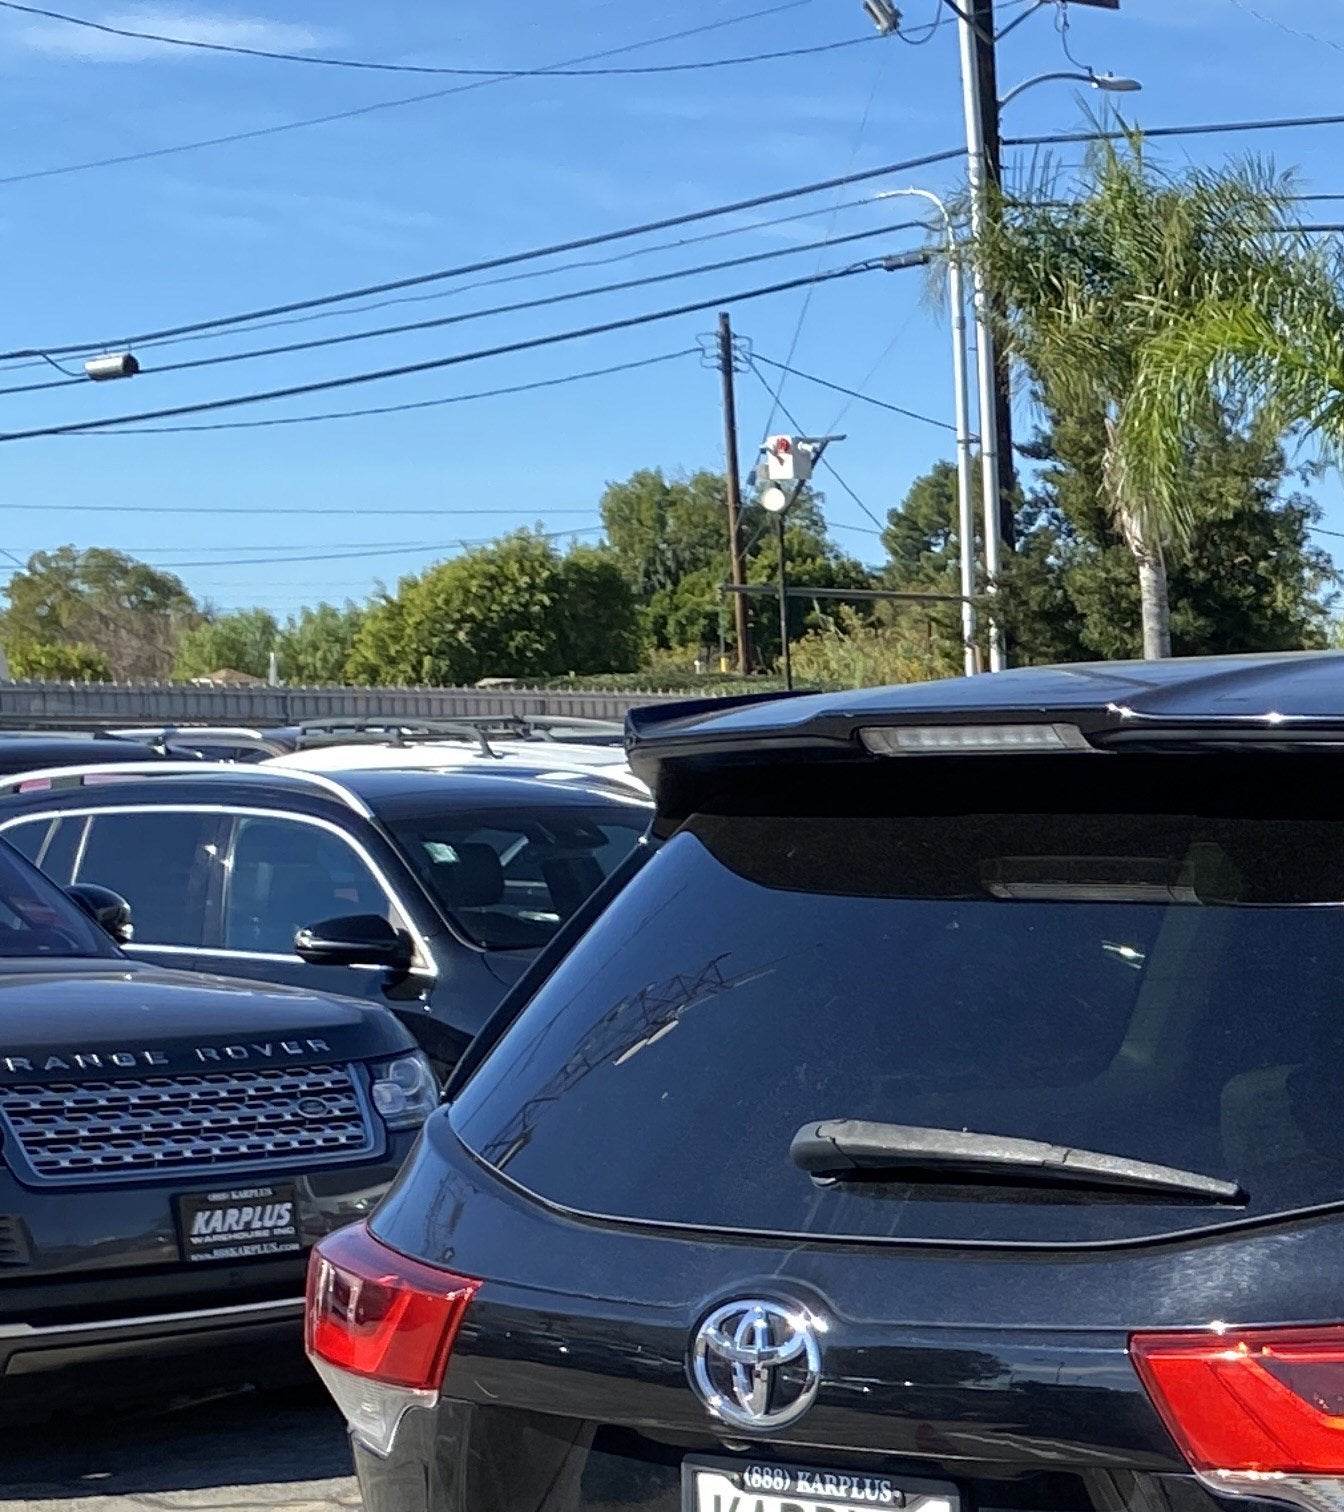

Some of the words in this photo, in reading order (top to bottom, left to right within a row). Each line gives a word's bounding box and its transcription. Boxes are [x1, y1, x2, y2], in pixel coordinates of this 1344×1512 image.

[5, 1050, 169, 1072] RANGE
[195, 1038, 331, 1062] ROVER
[191, 1202, 293, 1236] KARPLUS
[743, 1464, 791, 1491] (888)
[796, 1470, 893, 1502] KARPLUS
